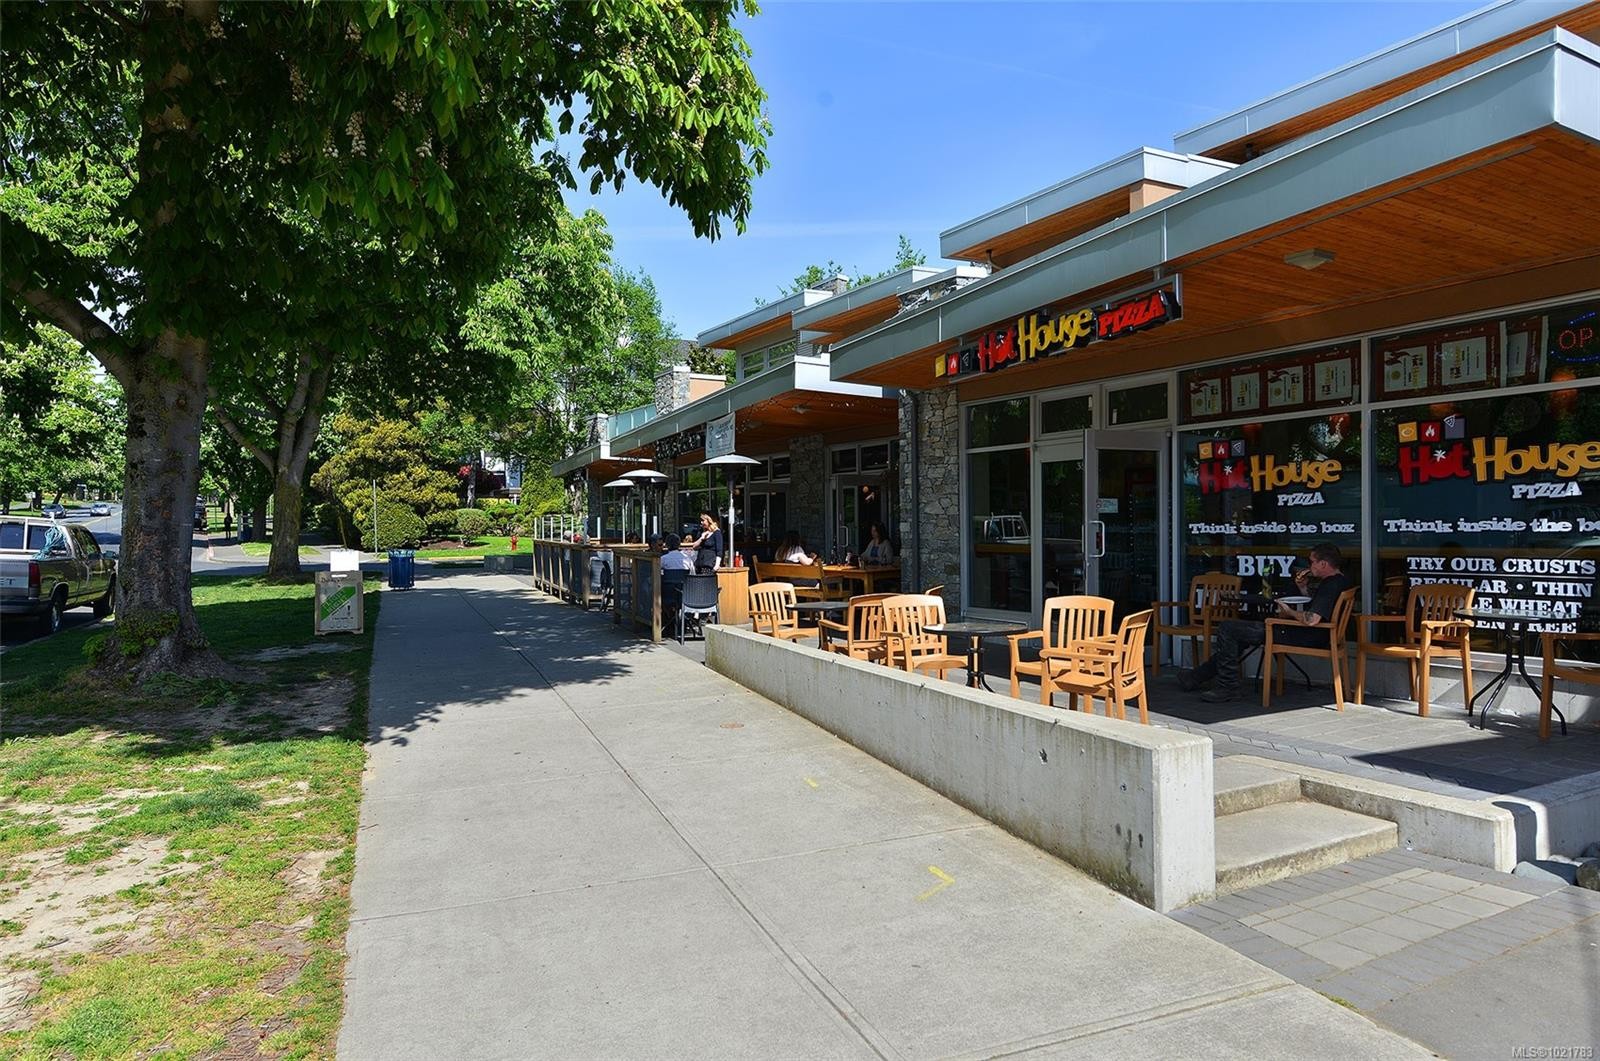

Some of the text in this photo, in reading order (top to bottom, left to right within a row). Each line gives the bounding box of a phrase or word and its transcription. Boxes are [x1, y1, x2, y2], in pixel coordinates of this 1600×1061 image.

[978, 294, 1165, 373] Hot House PIZZA
[1399, 436, 1600, 485] Hot House
[1199, 454, 1342, 495] Hot House
[1277, 492, 1324, 506] PIZZA
[1512, 481, 1582, 499] PIZZA
[1188, 521, 1355, 534] Think inside the box
[1383, 518, 1454, 533] Think
[1457, 516, 1527, 532] inside
[1529, 517, 1573, 532] the
[1236, 555, 1296, 578] BUY
[1407, 556, 1597, 575] TRY OUR CRUSTS
[1532, 580, 1593, 597] THIN
[1498, 597, 1582, 619] WHEAT
